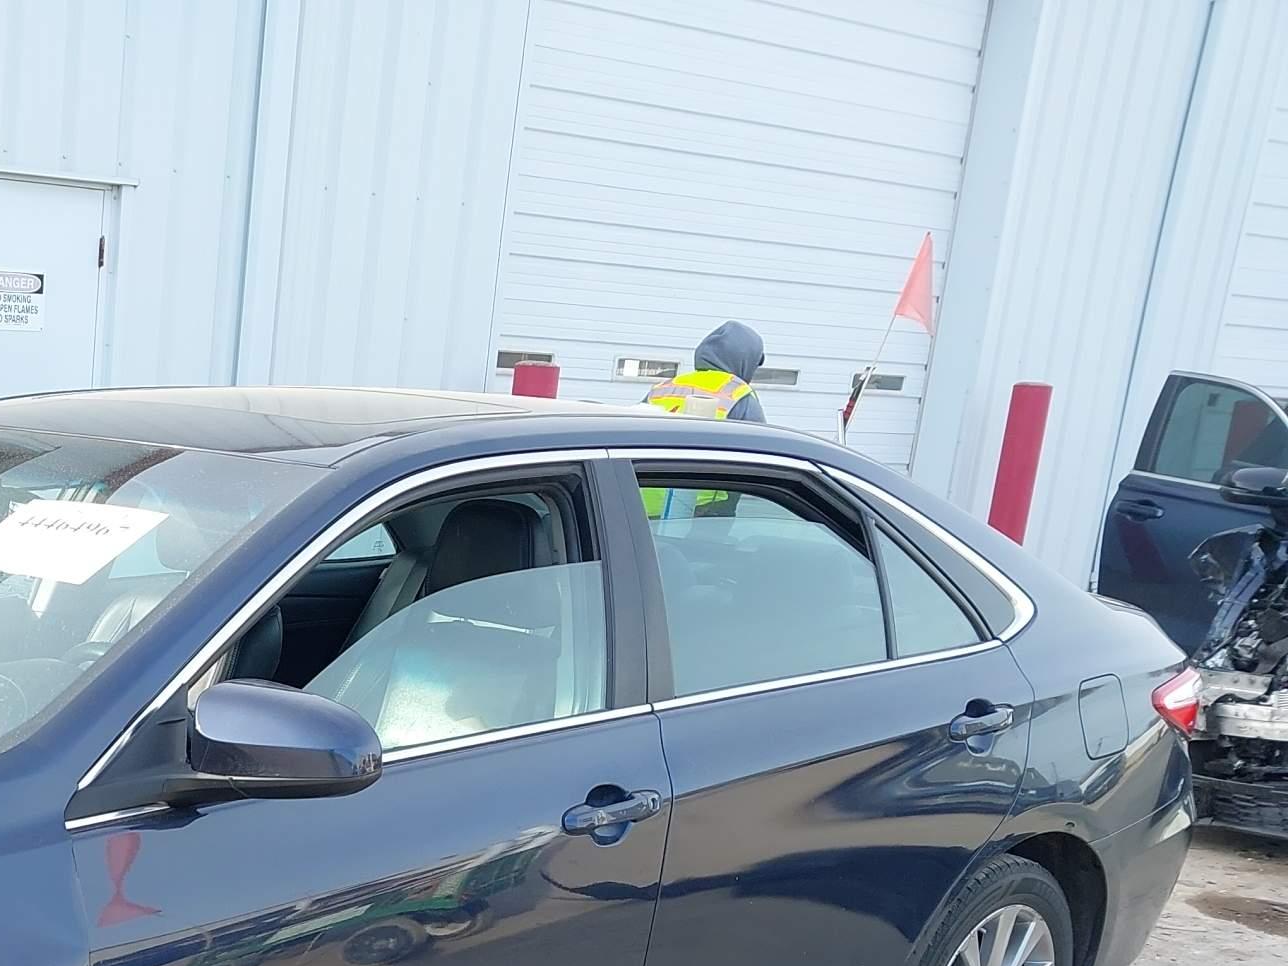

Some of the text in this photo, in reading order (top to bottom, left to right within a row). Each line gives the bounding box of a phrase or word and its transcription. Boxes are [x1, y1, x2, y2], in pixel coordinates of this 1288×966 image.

[3, 294, 32, 304] SMOKING
[14, 305, 39, 315] FLAMES
[4, 314, 29, 324] SPARKS
